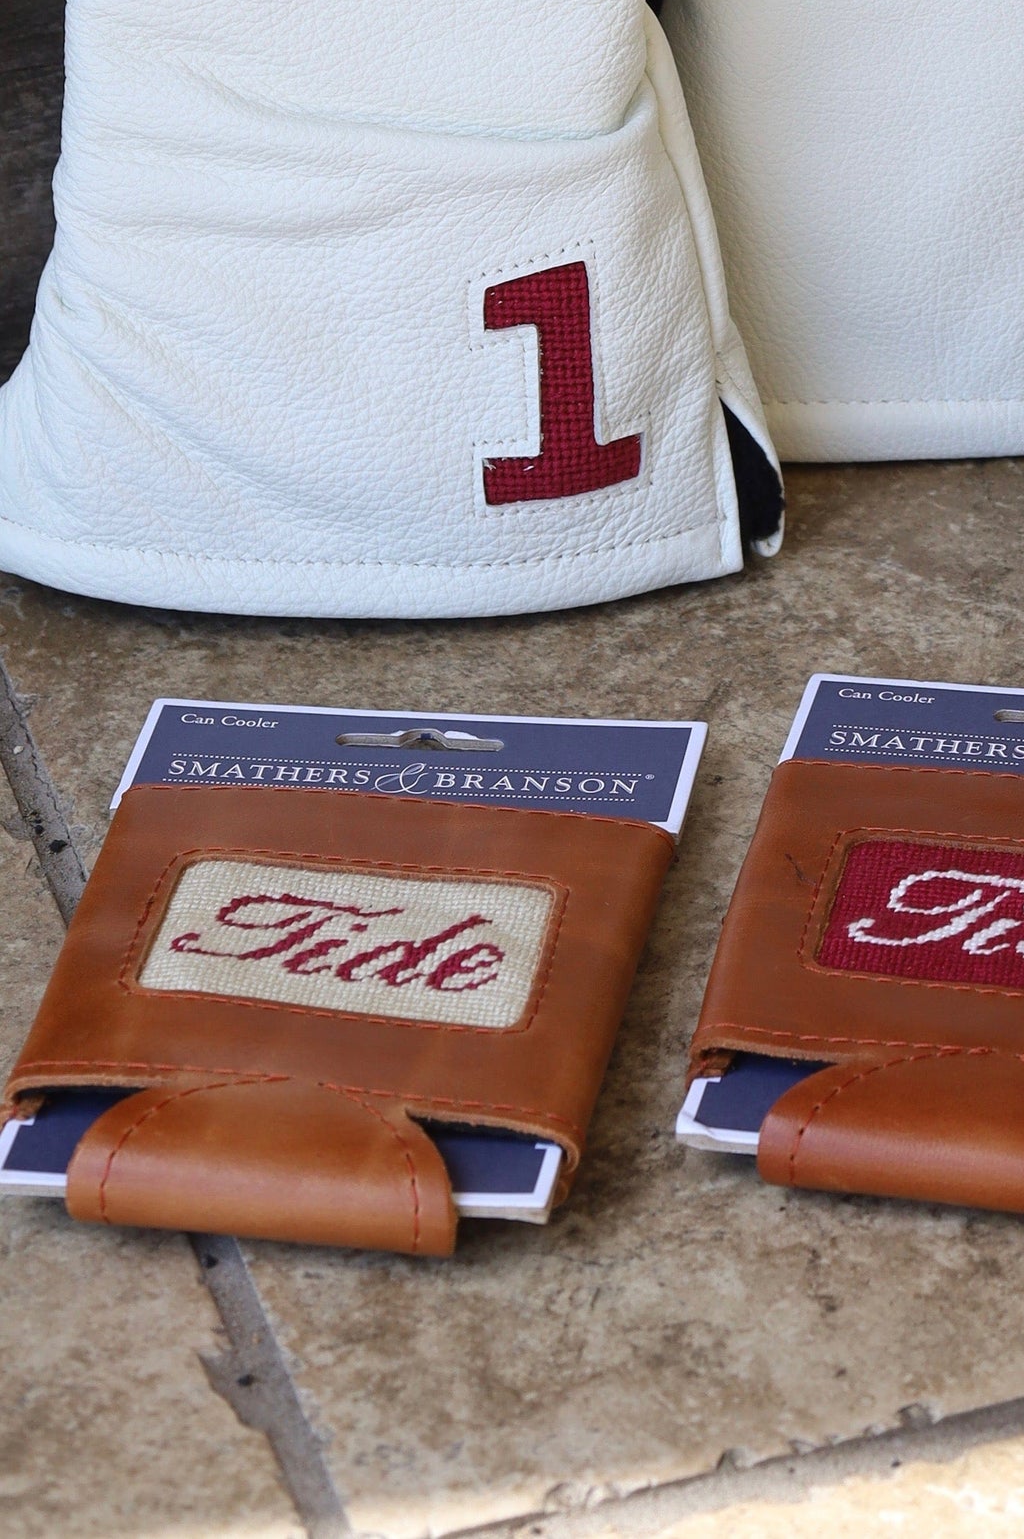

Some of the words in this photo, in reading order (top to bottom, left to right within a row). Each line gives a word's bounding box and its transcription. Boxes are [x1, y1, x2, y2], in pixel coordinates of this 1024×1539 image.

[483, 259, 643, 506] 1
[838, 688, 873, 700] Can
[878, 690, 936, 705] Cooler
[180, 712, 215, 725] Can
[220, 715, 279, 729] Cooler
[167, 759, 372, 785] SMATHERS
[170, 891, 506, 994] Tide
